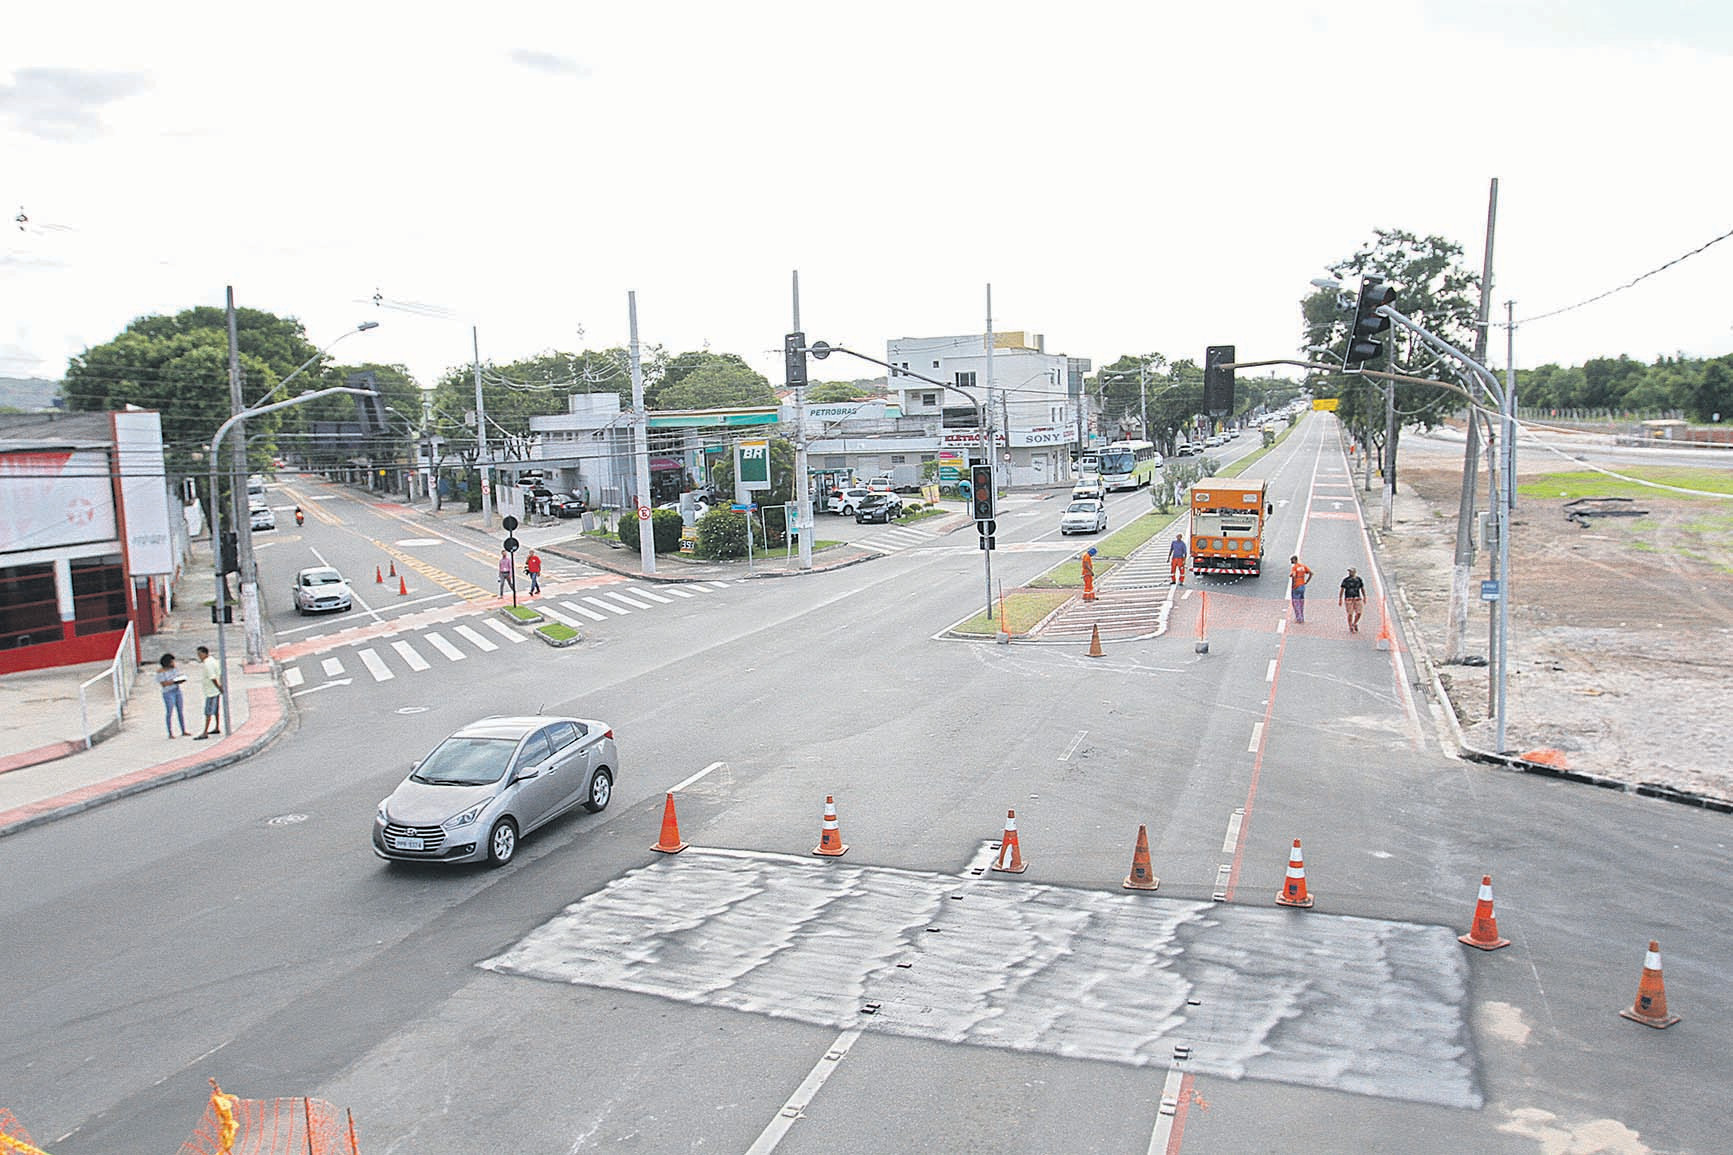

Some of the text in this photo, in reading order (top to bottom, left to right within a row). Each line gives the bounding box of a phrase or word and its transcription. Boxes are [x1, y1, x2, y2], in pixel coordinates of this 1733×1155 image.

[810, 408, 857, 416] PETROBRAS
[1026, 434, 1060, 443] SONY
[743, 448, 763, 459] BR
